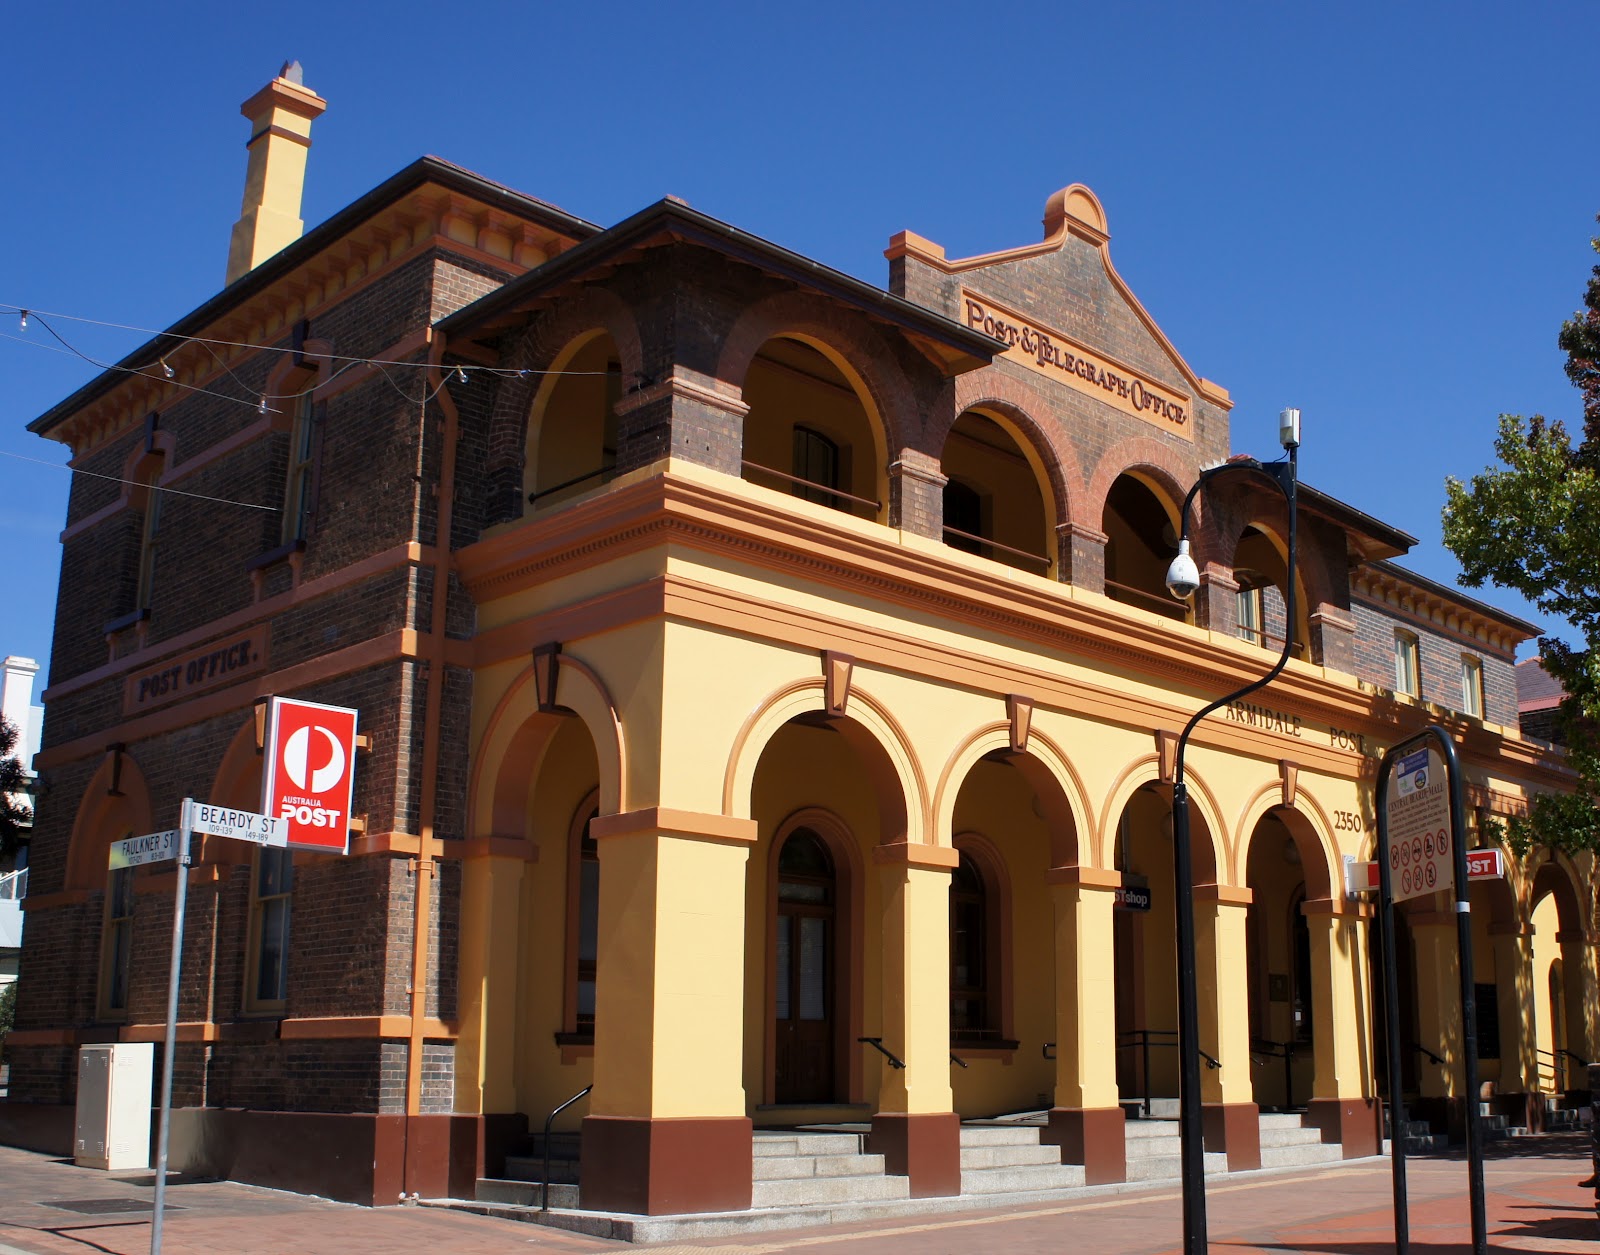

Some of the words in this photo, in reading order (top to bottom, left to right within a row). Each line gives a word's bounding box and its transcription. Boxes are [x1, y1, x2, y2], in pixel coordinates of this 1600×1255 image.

[1021, 326, 1037, 355] &
[1031, 329, 1127, 399] TELEGRAPH
[138, 664, 183, 702] POST
[1225, 700, 1302, 738] ARMIDALE
[1329, 727, 1365, 753] POST
[282, 795, 322, 807] AUSTRALIA
[201, 806, 254, 830] BEARDY
[261, 818, 277, 834] ST
[281, 804, 341, 829] POST
[1333, 810, 1362, 833] 2350
[122, 835, 161, 857] FAULKNER
[163, 832, 175, 849] ST
[208, 824, 233, 835] 109-139
[245, 830, 269, 842] 149-189
